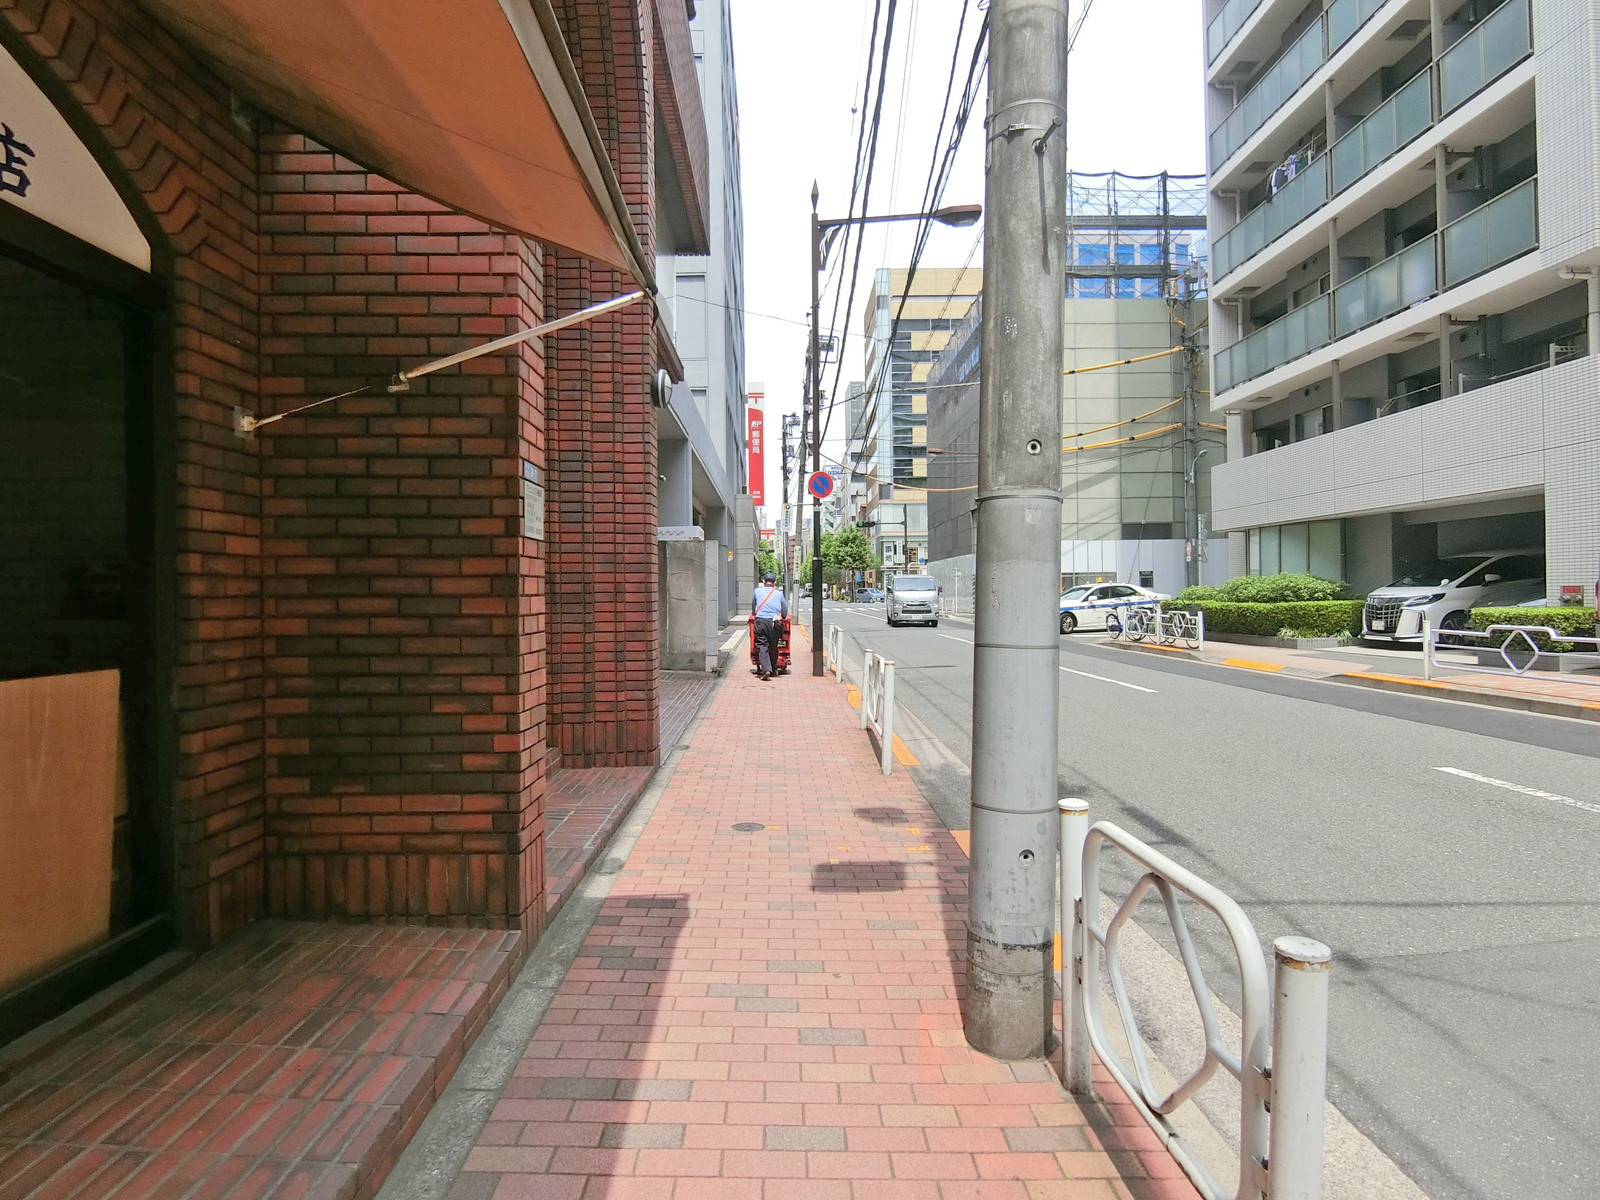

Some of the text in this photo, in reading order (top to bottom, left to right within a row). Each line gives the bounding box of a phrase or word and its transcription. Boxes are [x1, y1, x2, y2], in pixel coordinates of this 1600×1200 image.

[0, 122, 36, 198] 店
[752, 430, 760, 454] 郵便局
